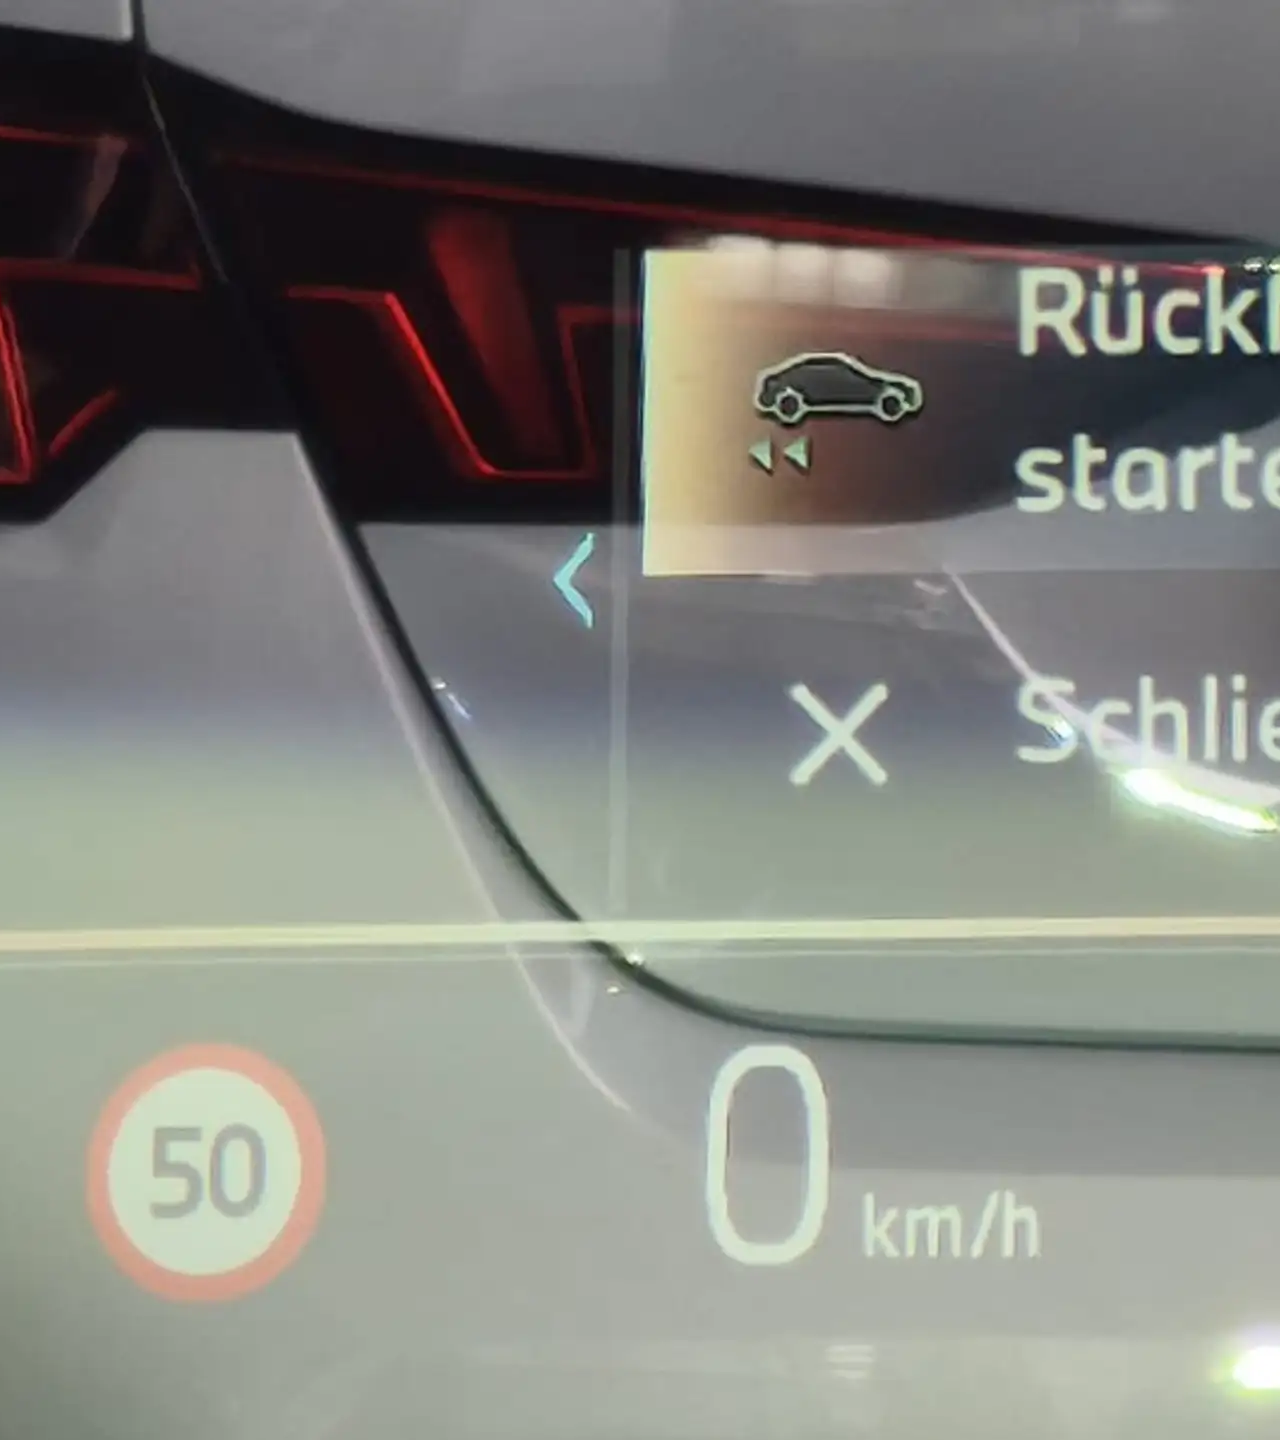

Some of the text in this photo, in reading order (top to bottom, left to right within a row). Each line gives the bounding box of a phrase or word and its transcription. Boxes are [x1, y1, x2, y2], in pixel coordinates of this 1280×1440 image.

[150, 1122, 267, 1221] 50
[705, 1043, 1042, 1266] 0 km/h
